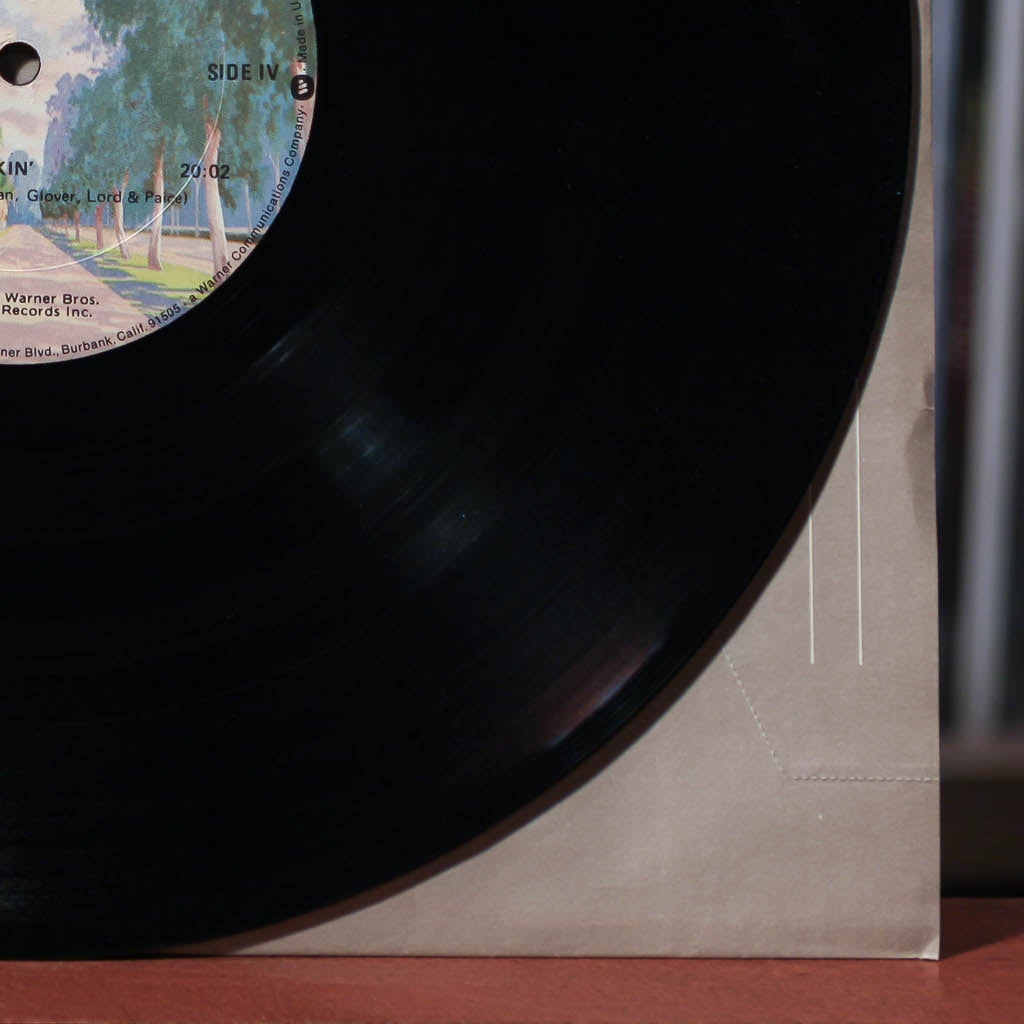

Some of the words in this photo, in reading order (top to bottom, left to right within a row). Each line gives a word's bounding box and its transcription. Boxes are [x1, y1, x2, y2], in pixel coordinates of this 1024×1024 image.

[295, 14, 305, 26] in
[297, 30, 308, 63] Made
[207, 63, 251, 82] SIDE
[259, 63, 280, 81] IV
[180, 163, 231, 180] 20:02
[27, 189, 81, 205] Glover,
[87, 190, 122, 204] Lord
[127, 190, 139, 204] &
[25, 346, 60, 357] Blvd.,
[116, 323, 149, 343] Calif.
[147, 303, 182, 328] 91505
[197, 260, 234, 294] Warner
[231, 169, 291, 262] Communications
[4, 292, 57, 304] Warner
[62, 293, 100, 306] Bros.
[1, 304, 61, 317] Records
[66, 306, 93, 318] Inc.
